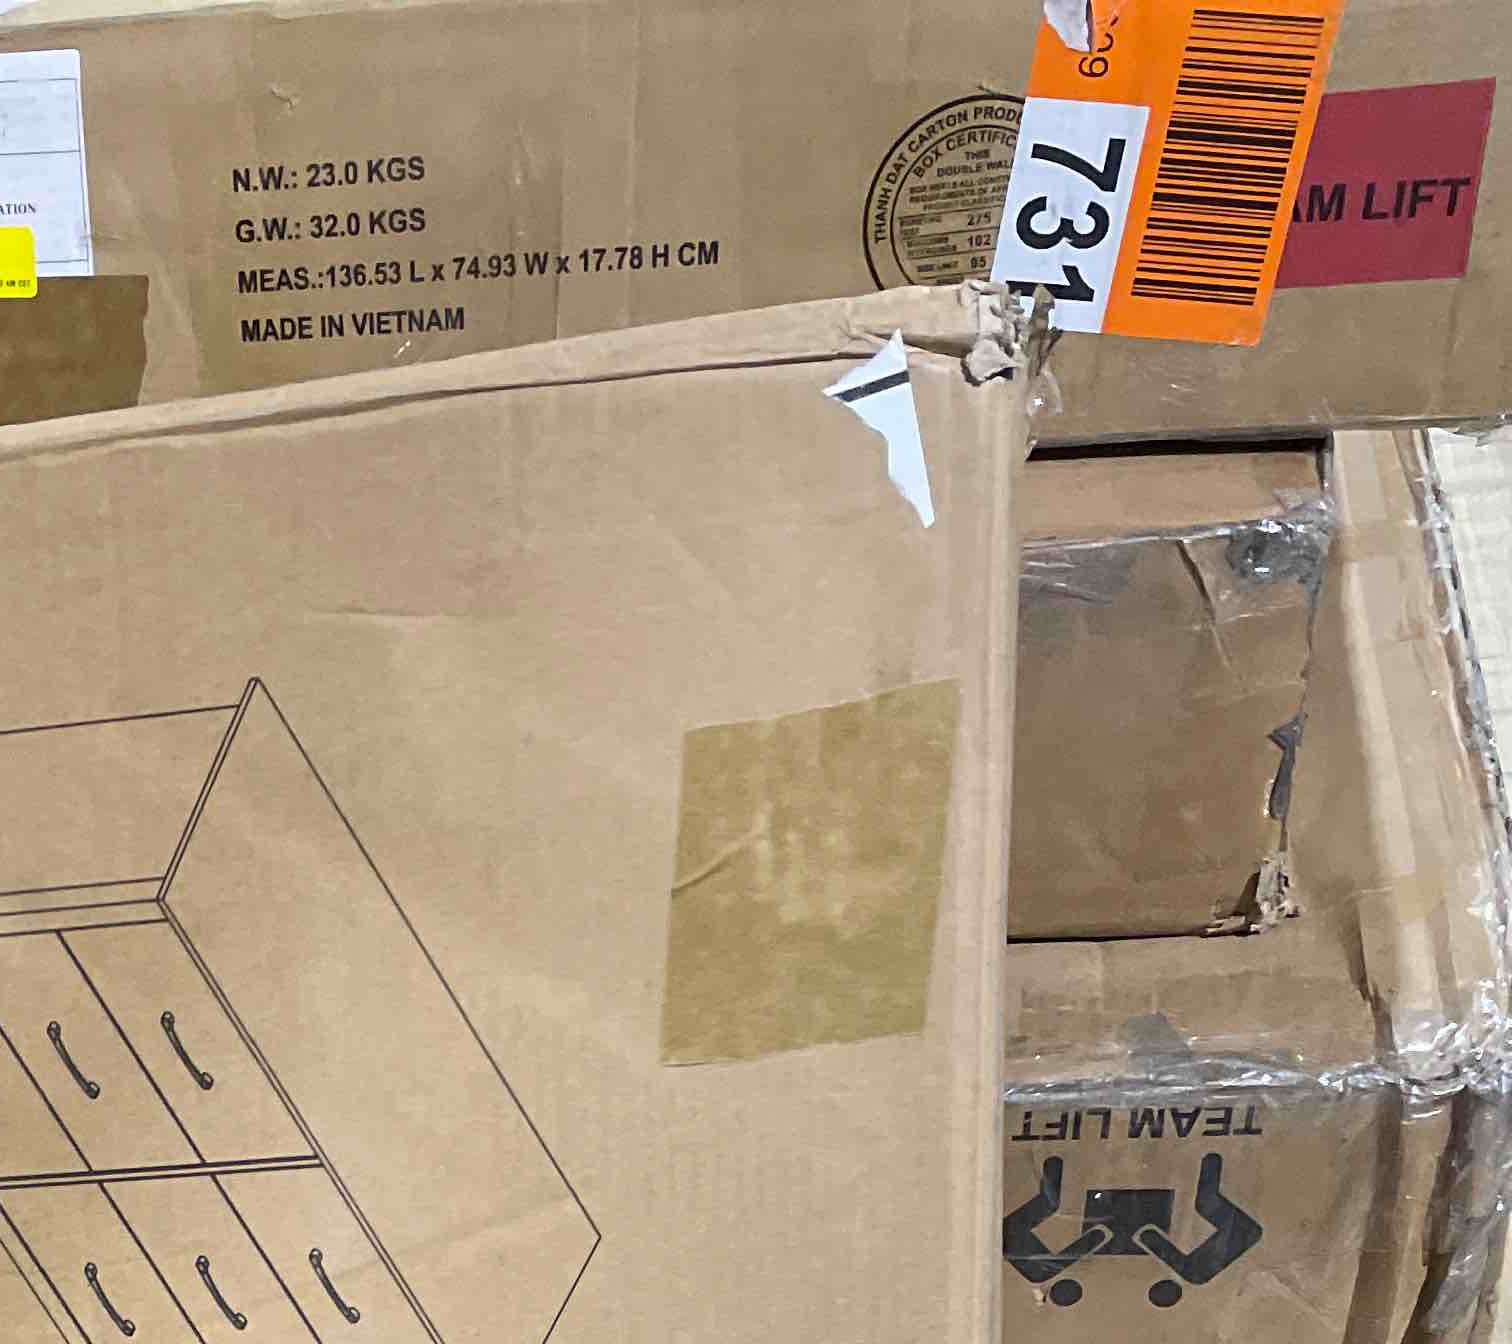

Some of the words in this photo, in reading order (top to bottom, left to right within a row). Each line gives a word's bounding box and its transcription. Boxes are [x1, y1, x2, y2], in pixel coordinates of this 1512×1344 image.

[232, 165, 298, 193] N.W.:
[306, 161, 359, 188] 23.0
[367, 156, 426, 184] KGS
[874, 186, 894, 244] THANH
[889, 152, 909, 185] DAT
[908, 110, 969, 152] CARTON
[913, 147, 944, 179] BOX
[1362, 178, 1471, 220] LIFT
[235, 216, 302, 243] G.W.:
[309, 211, 361, 239] 32.0
[369, 207, 426, 235] KGS
[1006, 138, 1127, 302] 731
[408, 260, 425, 284] L
[431, 265, 445, 281] x
[452, 253, 517, 281] 74.93
[523, 250, 550, 276] W
[555, 257, 570, 275] x
[577, 245, 644, 273] 17.78
[651, 244, 670, 268] H
[677, 240, 720, 267] CM
[240, 316, 313, 343] MADE
[319, 313, 345, 338] IN
[351, 306, 466, 336] VIETNAM
[1011, 1109, 1110, 1141] LIFT
[1128, 1104, 1263, 1137] TEAM
